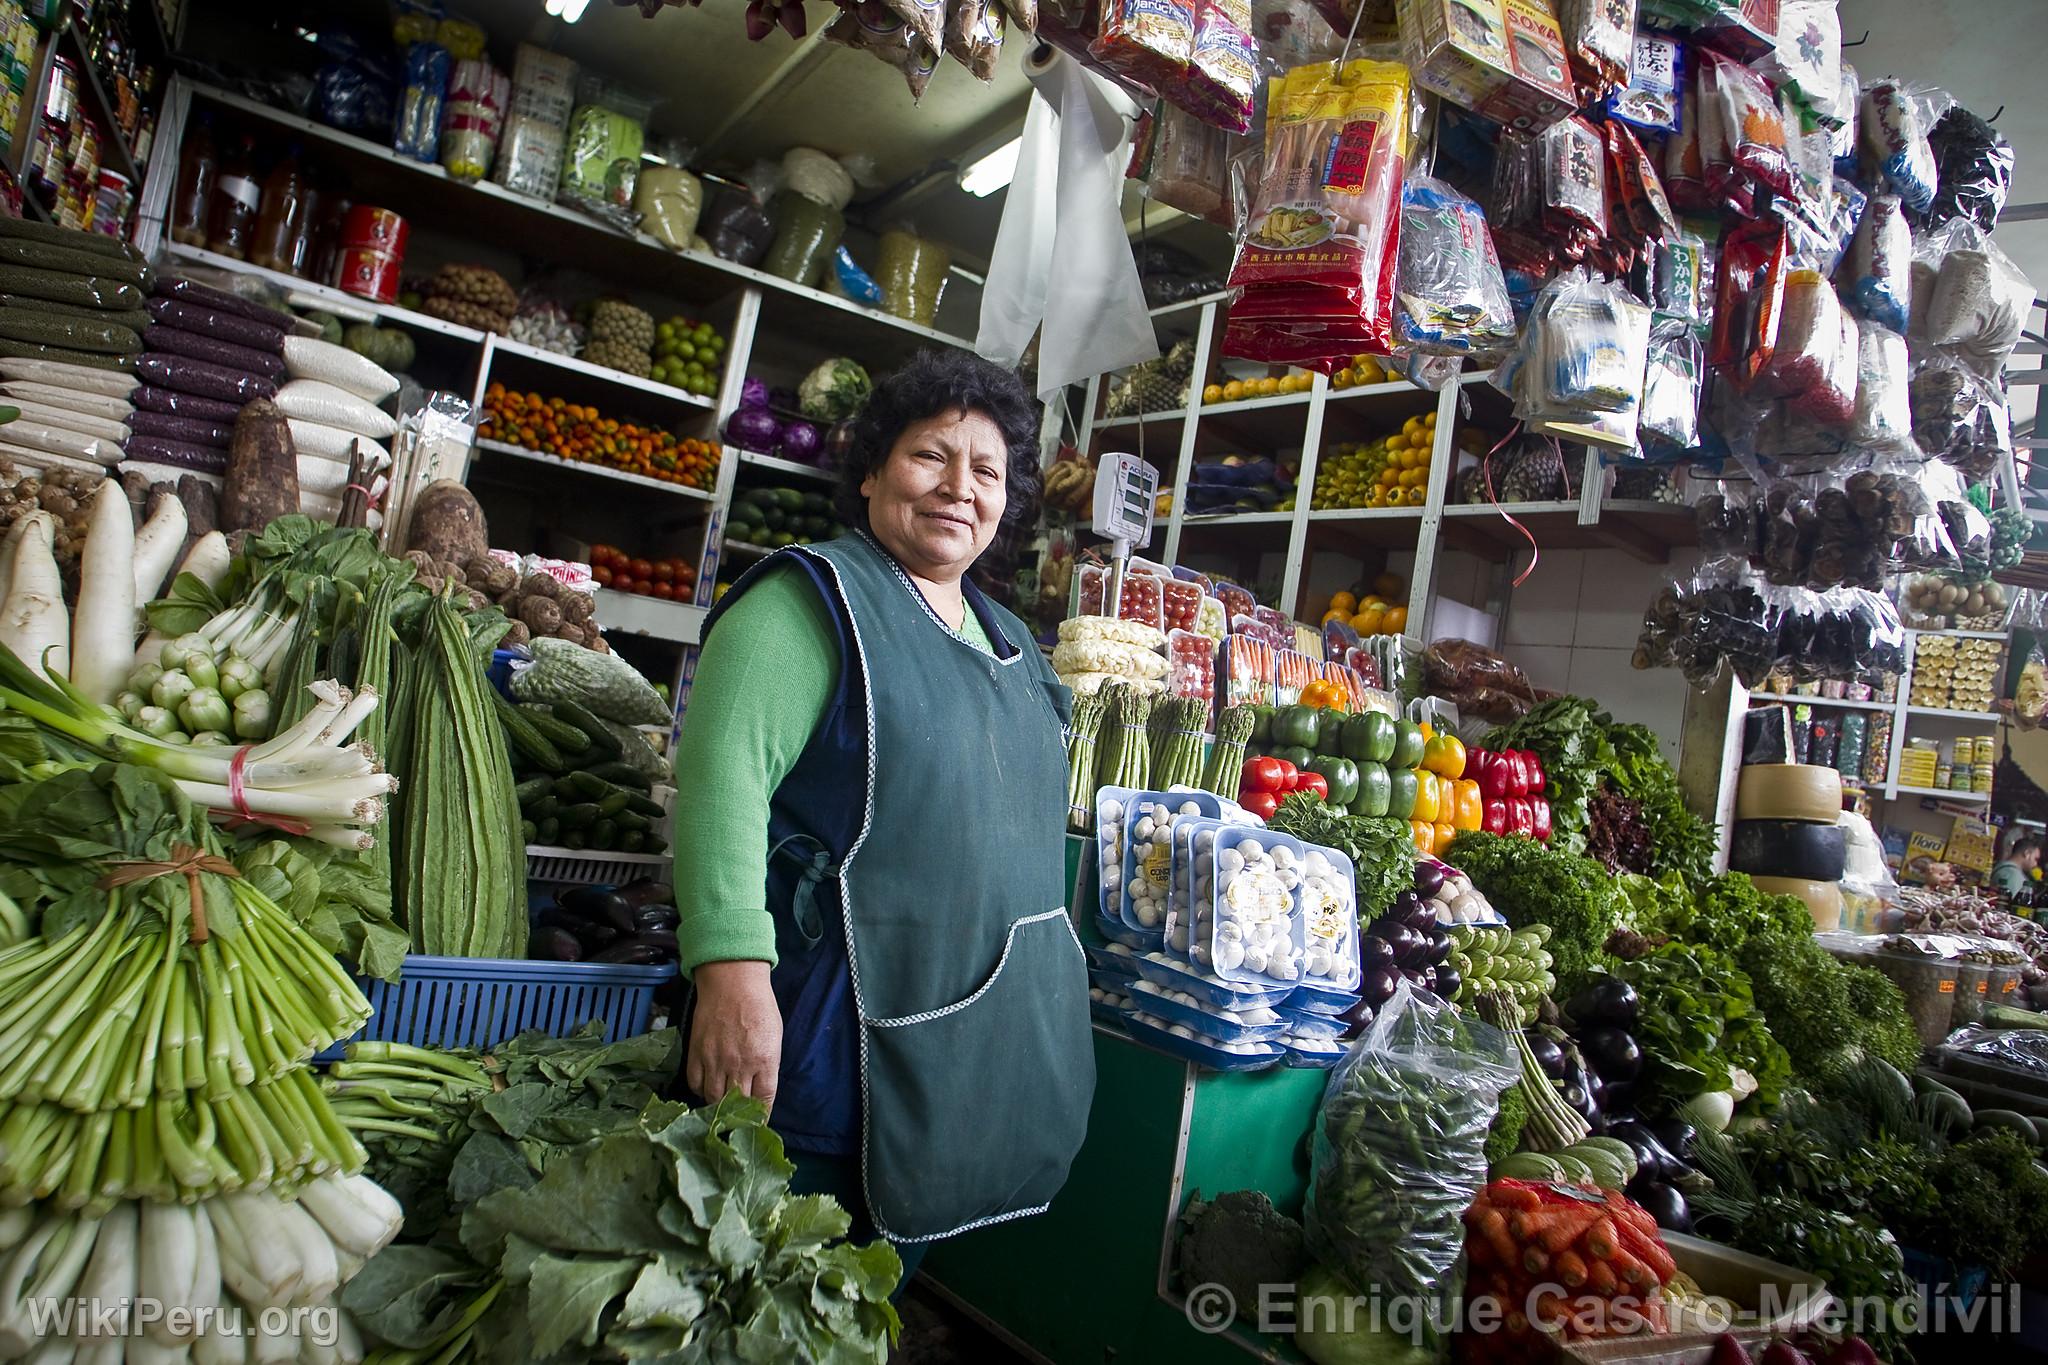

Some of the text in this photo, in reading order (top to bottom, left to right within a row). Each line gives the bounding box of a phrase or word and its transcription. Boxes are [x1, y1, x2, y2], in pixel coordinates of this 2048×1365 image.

[1507, 8, 1560, 42] SOYA
[1673, 247, 1690, 297] わかめ
[1911, 834, 1942, 852] flora
